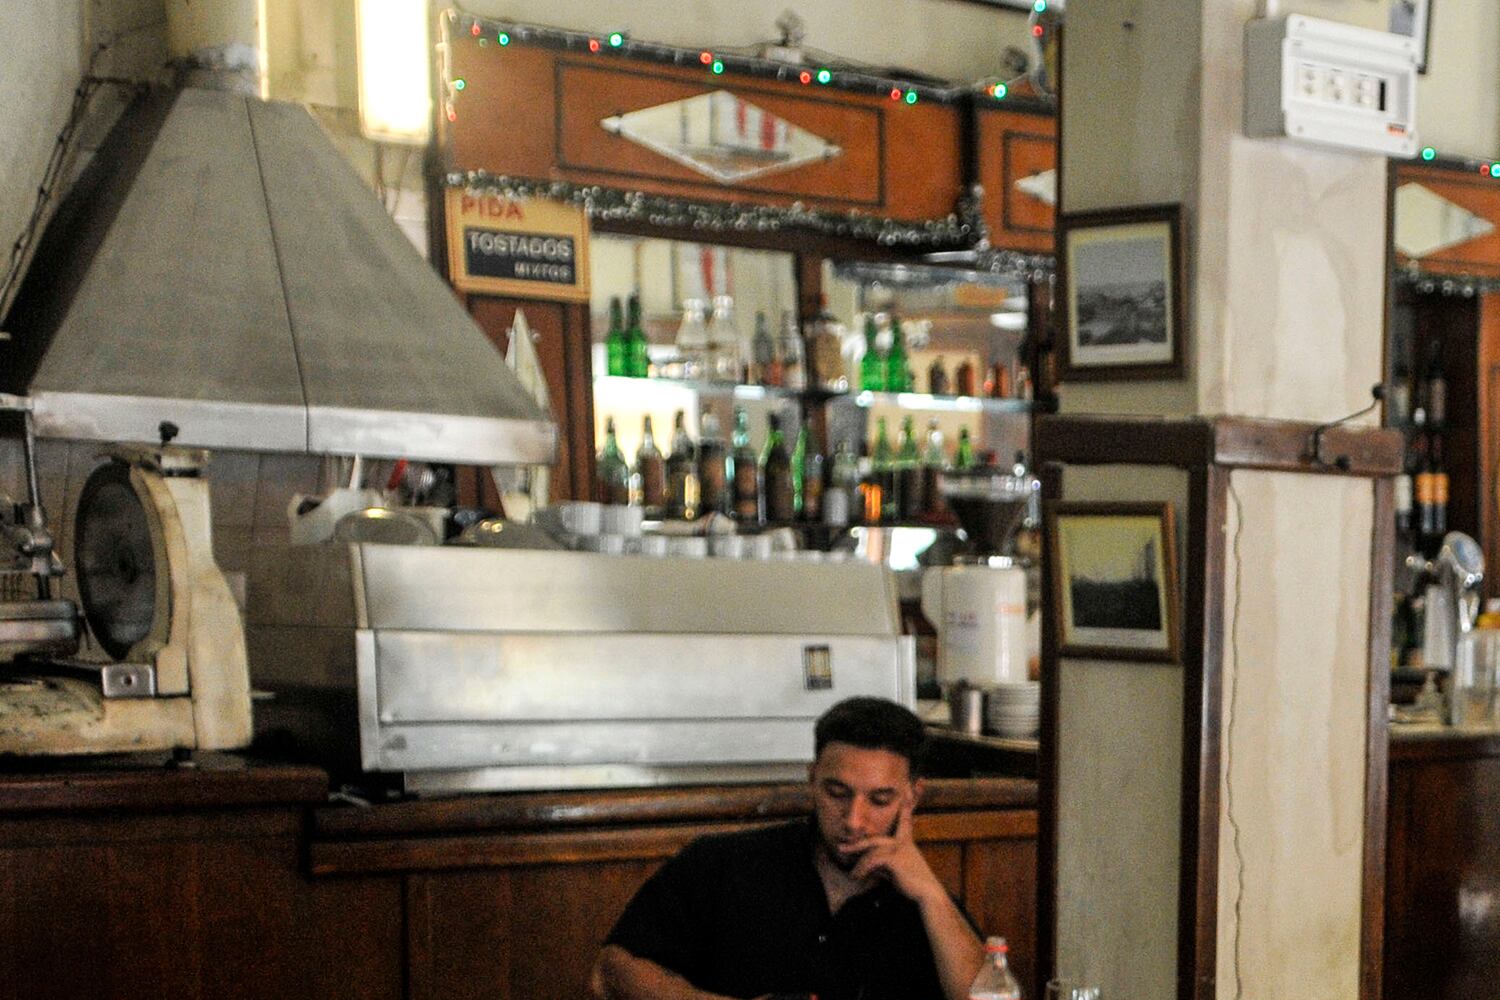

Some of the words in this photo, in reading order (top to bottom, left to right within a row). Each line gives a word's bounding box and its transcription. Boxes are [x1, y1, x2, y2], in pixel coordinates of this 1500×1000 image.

[462, 194, 524, 220] PIDA
[470, 231, 572, 262] TOSTADOS
[514, 261, 572, 281] MIXTOS
